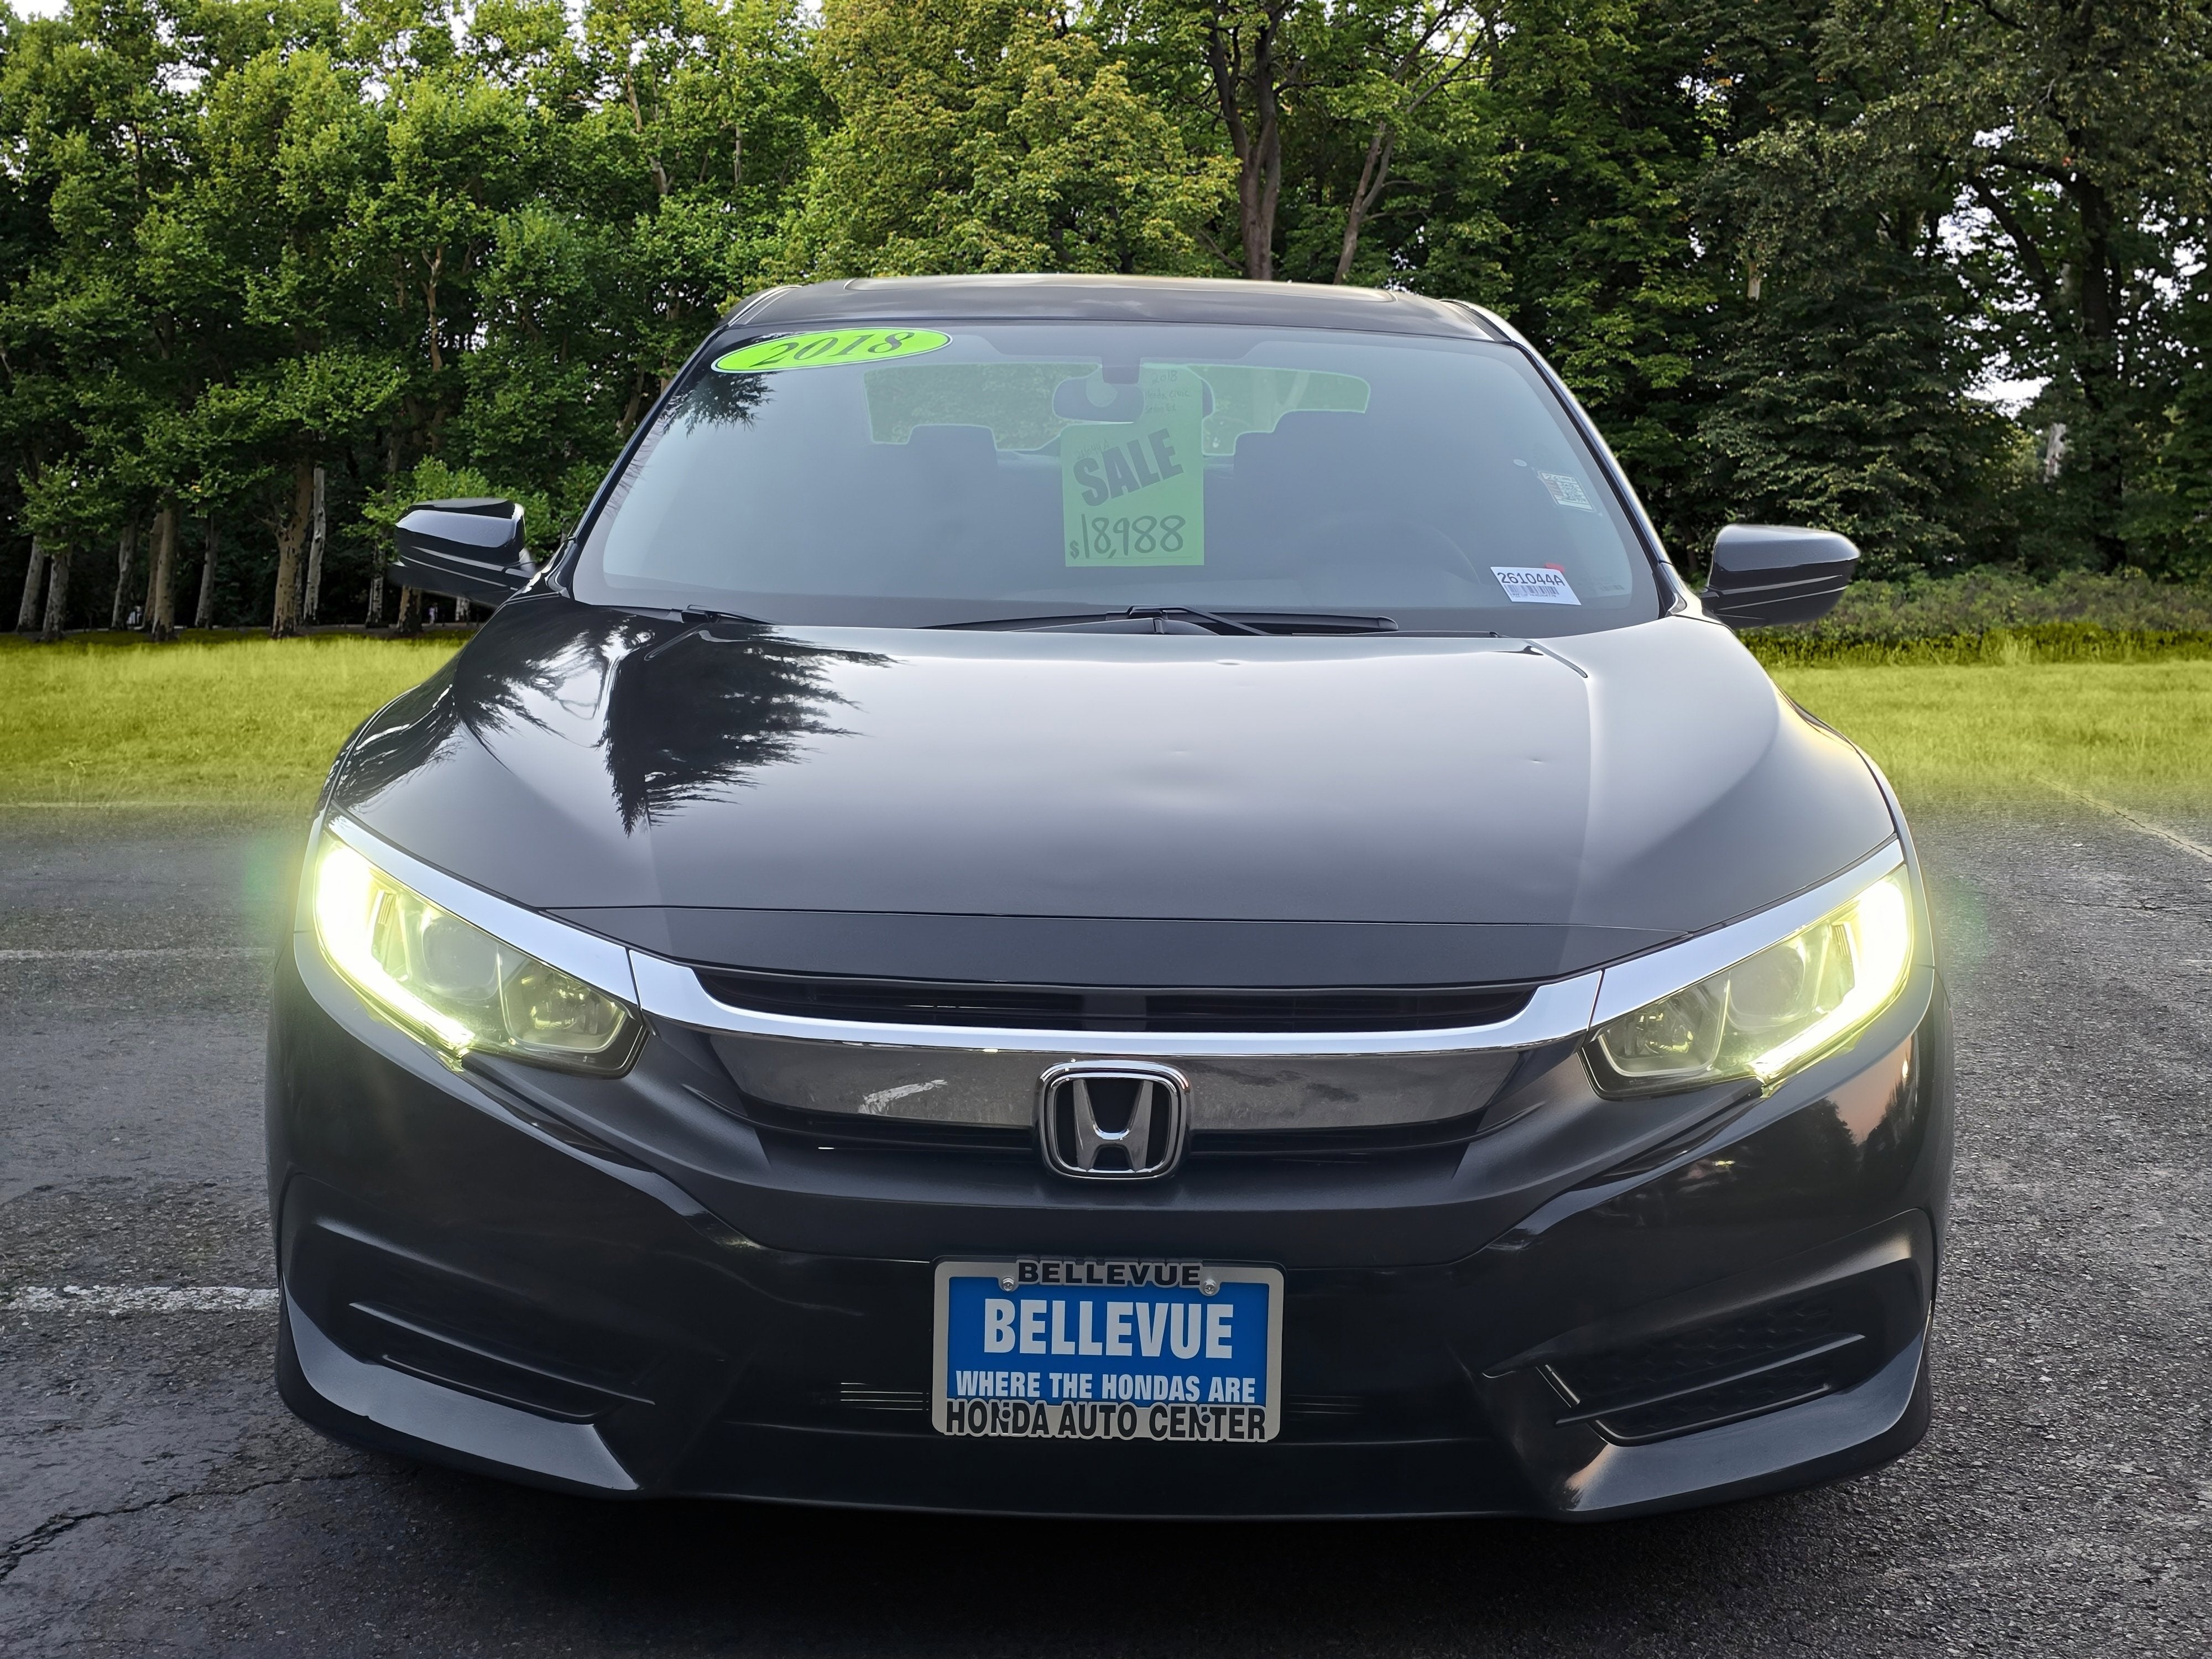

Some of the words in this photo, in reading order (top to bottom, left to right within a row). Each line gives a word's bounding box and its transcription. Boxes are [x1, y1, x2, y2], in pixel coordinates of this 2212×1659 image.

[749, 332, 914, 367] 2018
[1073, 428, 1184, 506] SALE
[1070, 514, 1186, 559] $18,988
[1498, 572, 1565, 586] 261044A
[1018, 1262, 1201, 1286] BELLEVUE
[984, 1298, 1234, 1359] BELLEVUE
[956, 1370, 1040, 1397] WHERE
[1050, 1373, 1092, 1399] THE
[1102, 1374, 1200, 1402] HONDAS
[1208, 1376, 1255, 1404] ARE
[946, 1401, 1050, 1435] HONDA
[1058, 1404, 1137, 1437] AUTO
[1149, 1405, 1265, 1440] CENTER
